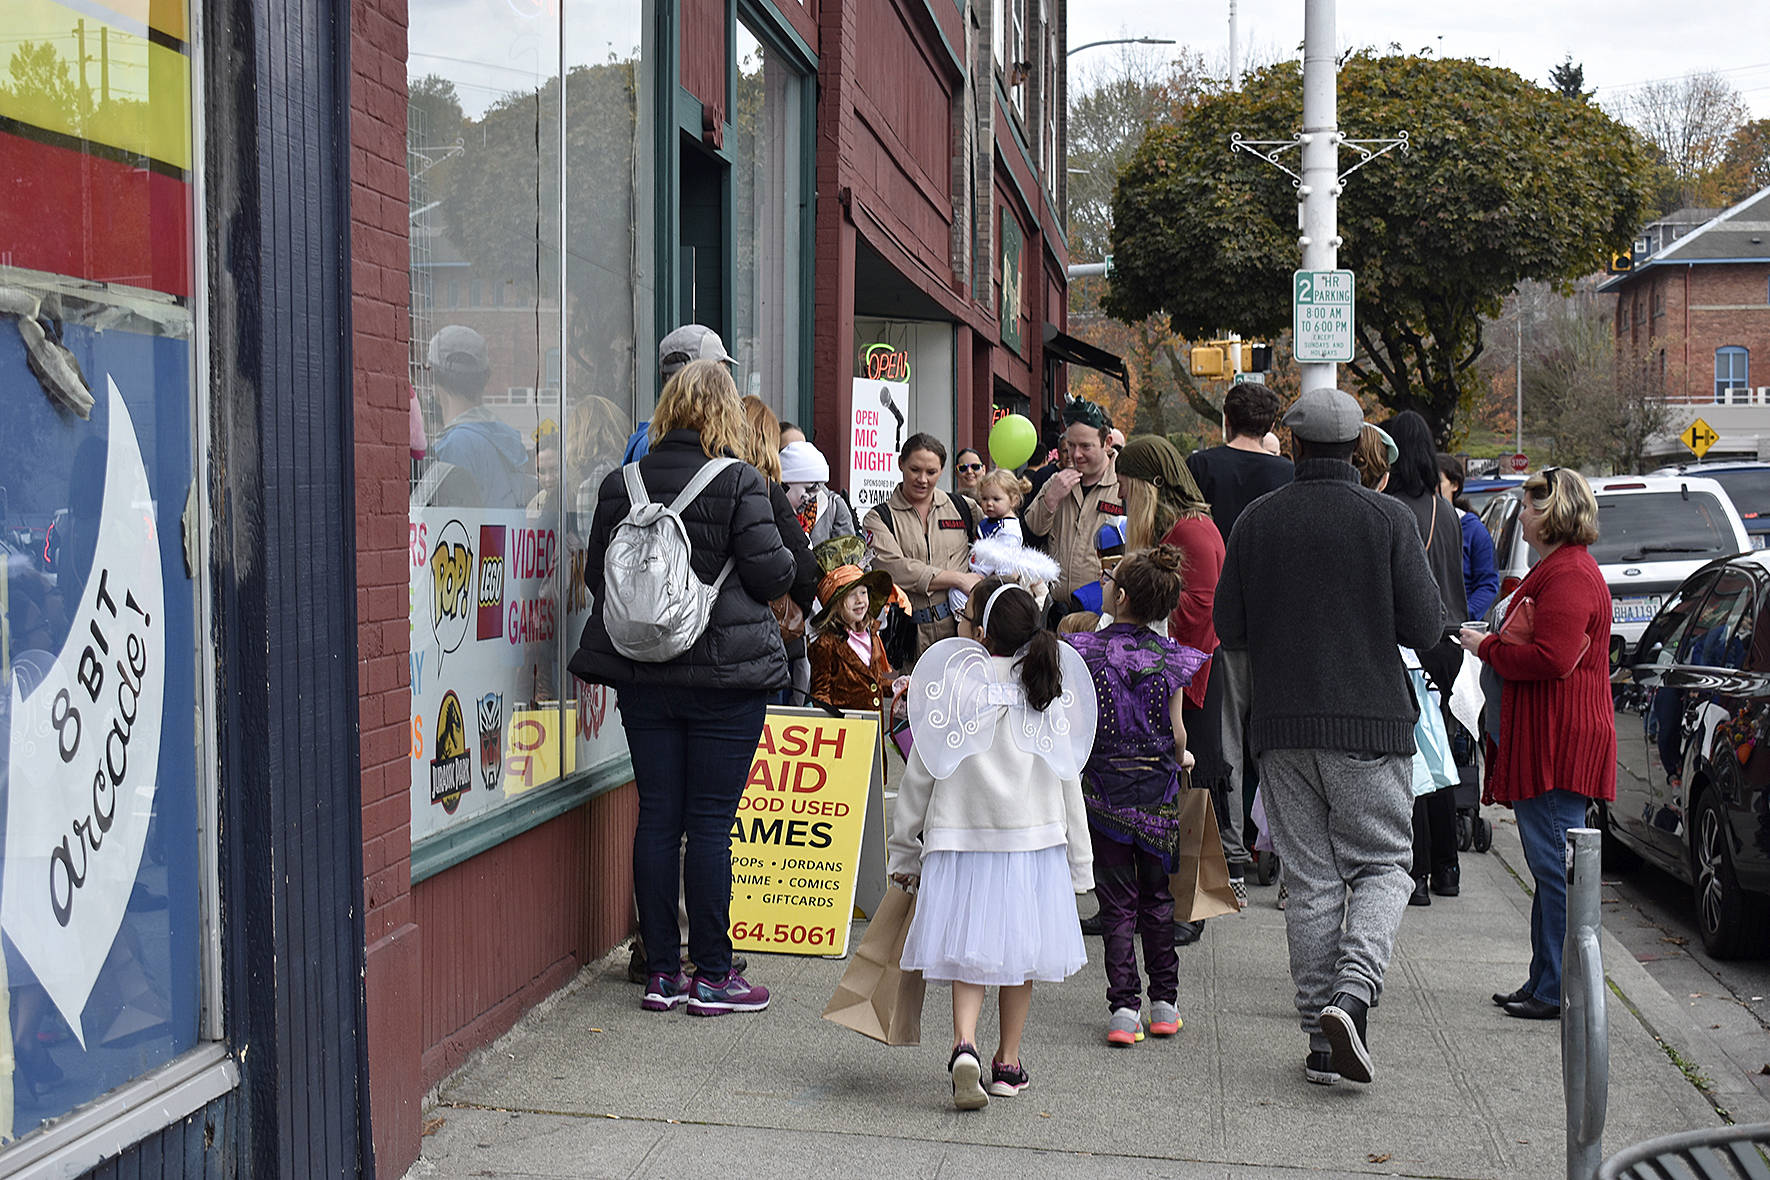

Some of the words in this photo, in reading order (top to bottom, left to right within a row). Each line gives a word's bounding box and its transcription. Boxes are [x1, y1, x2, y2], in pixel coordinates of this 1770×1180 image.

[1299, 279, 1311, 301] 2
[1325, 276, 1339, 287] HR
[1314, 290, 1350, 301] PARKING
[1306, 307, 1325, 318] 8:00
[1330, 307, 1341, 318] AM
[1302, 321, 1312, 332] TO
[1314, 321, 1333, 332] 6:00
[1335, 321, 1348, 332] PM
[868, 350, 908, 380] OPEN
[855, 409, 879, 426] OPEN
[855, 428, 878, 448] MIC
[854, 450, 893, 472] NIGHT
[1511, 459, 1528, 468] STOP
[863, 479, 889, 488] SPONSORED
[889, 480, 895, 488] BY
[511, 528, 556, 579] VIDEO
[430, 540, 473, 630] POP!
[479, 557, 503, 607] LEGO
[508, 598, 554, 645] GAMES
[78, 568, 117, 703] BIT
[50, 588, 152, 928] arcade!
[432, 763, 455, 799] JURASSIC
[455, 757, 471, 790] PARK
[791, 799, 850, 817] USED
[781, 858, 843, 872] JORDANS
[789, 877, 840, 890] COMICS
[762, 893, 834, 908] GIFTCARDS
[731, 921, 836, 946] 64.5061
